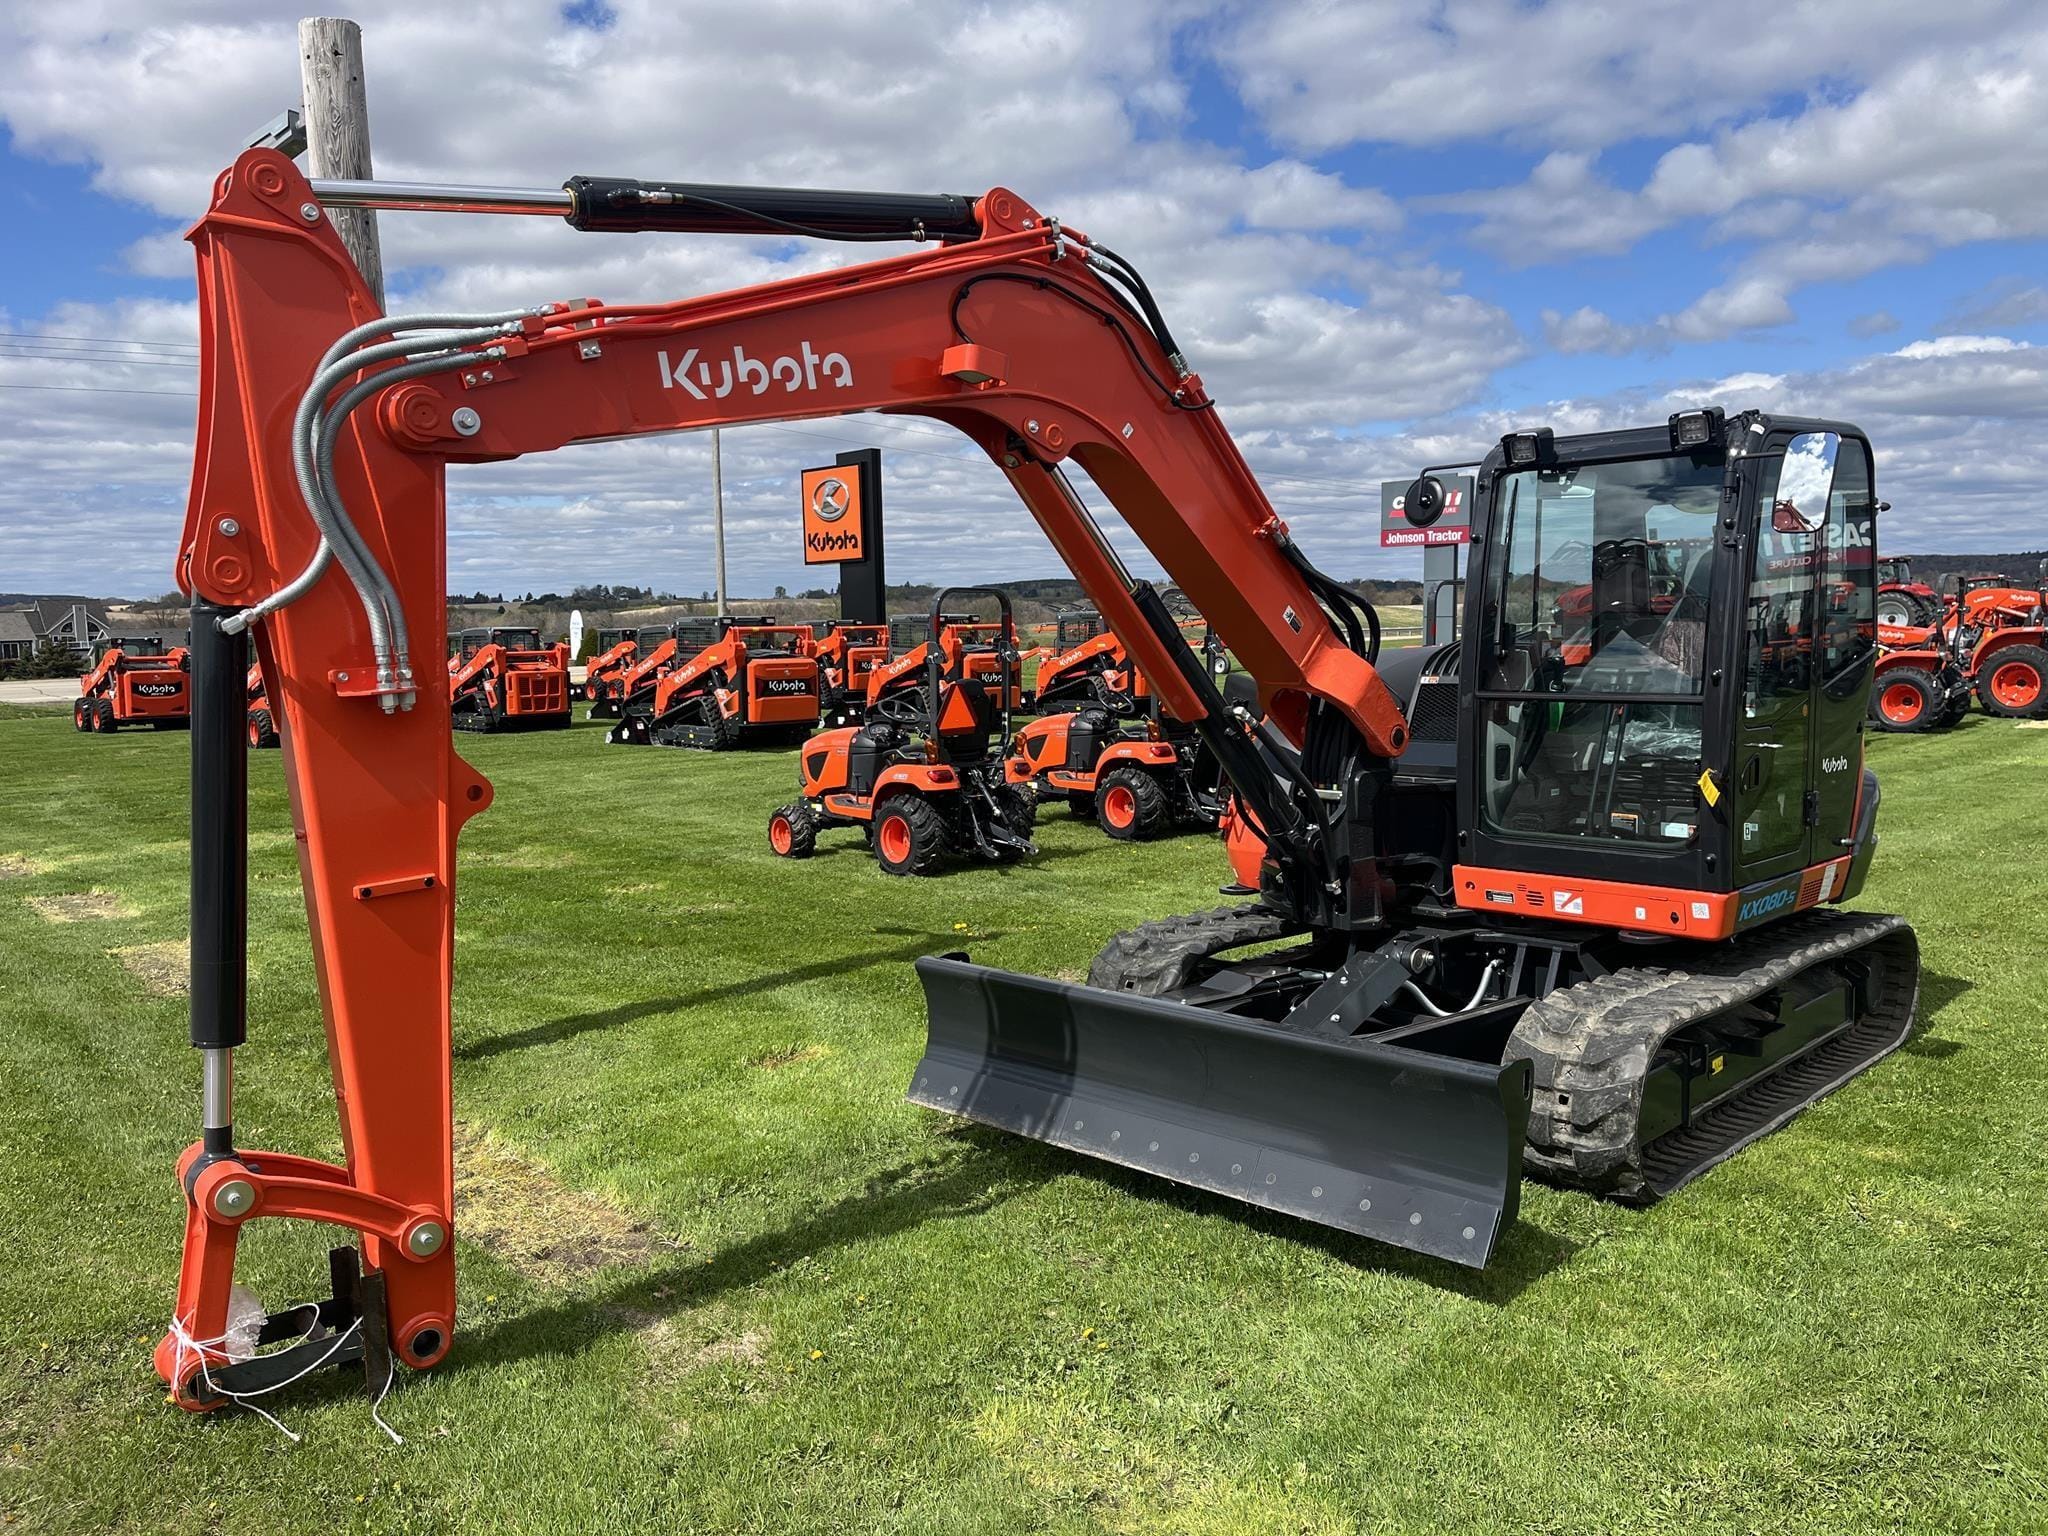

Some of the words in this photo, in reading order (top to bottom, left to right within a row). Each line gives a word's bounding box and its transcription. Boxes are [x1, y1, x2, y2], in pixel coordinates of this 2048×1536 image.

[657, 341, 854, 400] Kubota
[808, 530, 858, 552] Kubota
[1386, 532, 1425, 544] Johnson
[1427, 530, 1463, 542] Tractor
[887, 657, 912, 675] Kubota
[1058, 650, 1083, 666] Kubota
[768, 679, 806, 691] Kubota
[981, 672, 1003, 683] Kubo
[138, 684, 176, 694] Kubota
[1822, 755, 1848, 774] Kubota
